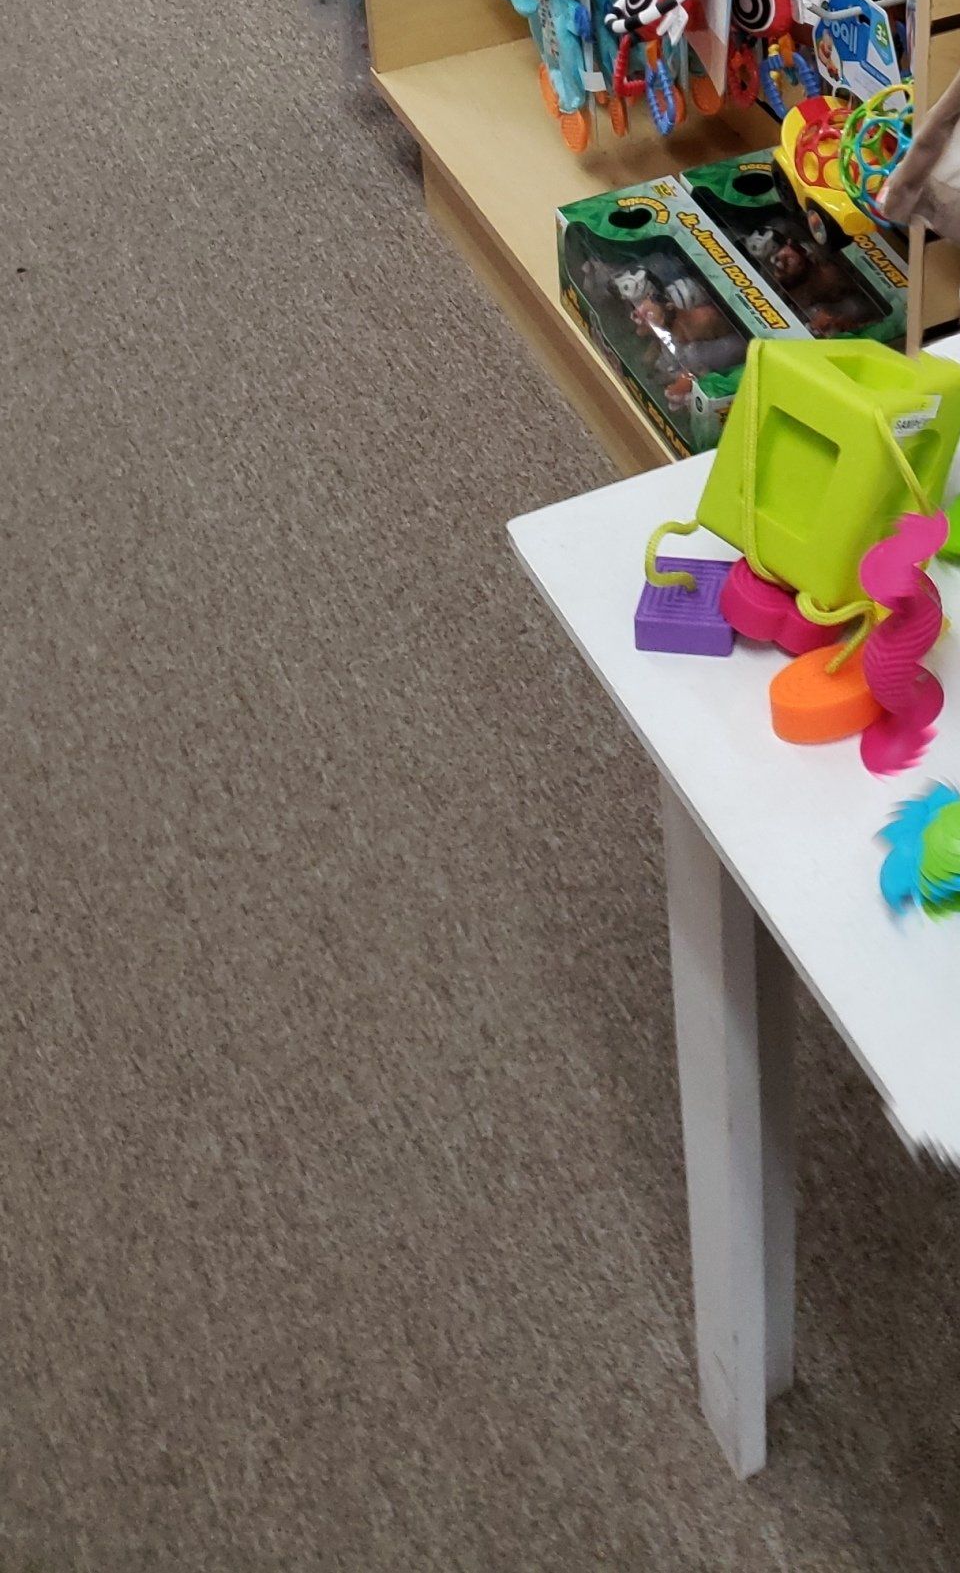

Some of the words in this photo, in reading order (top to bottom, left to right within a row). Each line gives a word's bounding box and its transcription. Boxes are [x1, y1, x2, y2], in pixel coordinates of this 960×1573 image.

[690, 228, 733, 266] JUNGLE
[722, 265, 751, 293] ZOO
[739, 284, 790, 330] PLAYSET
